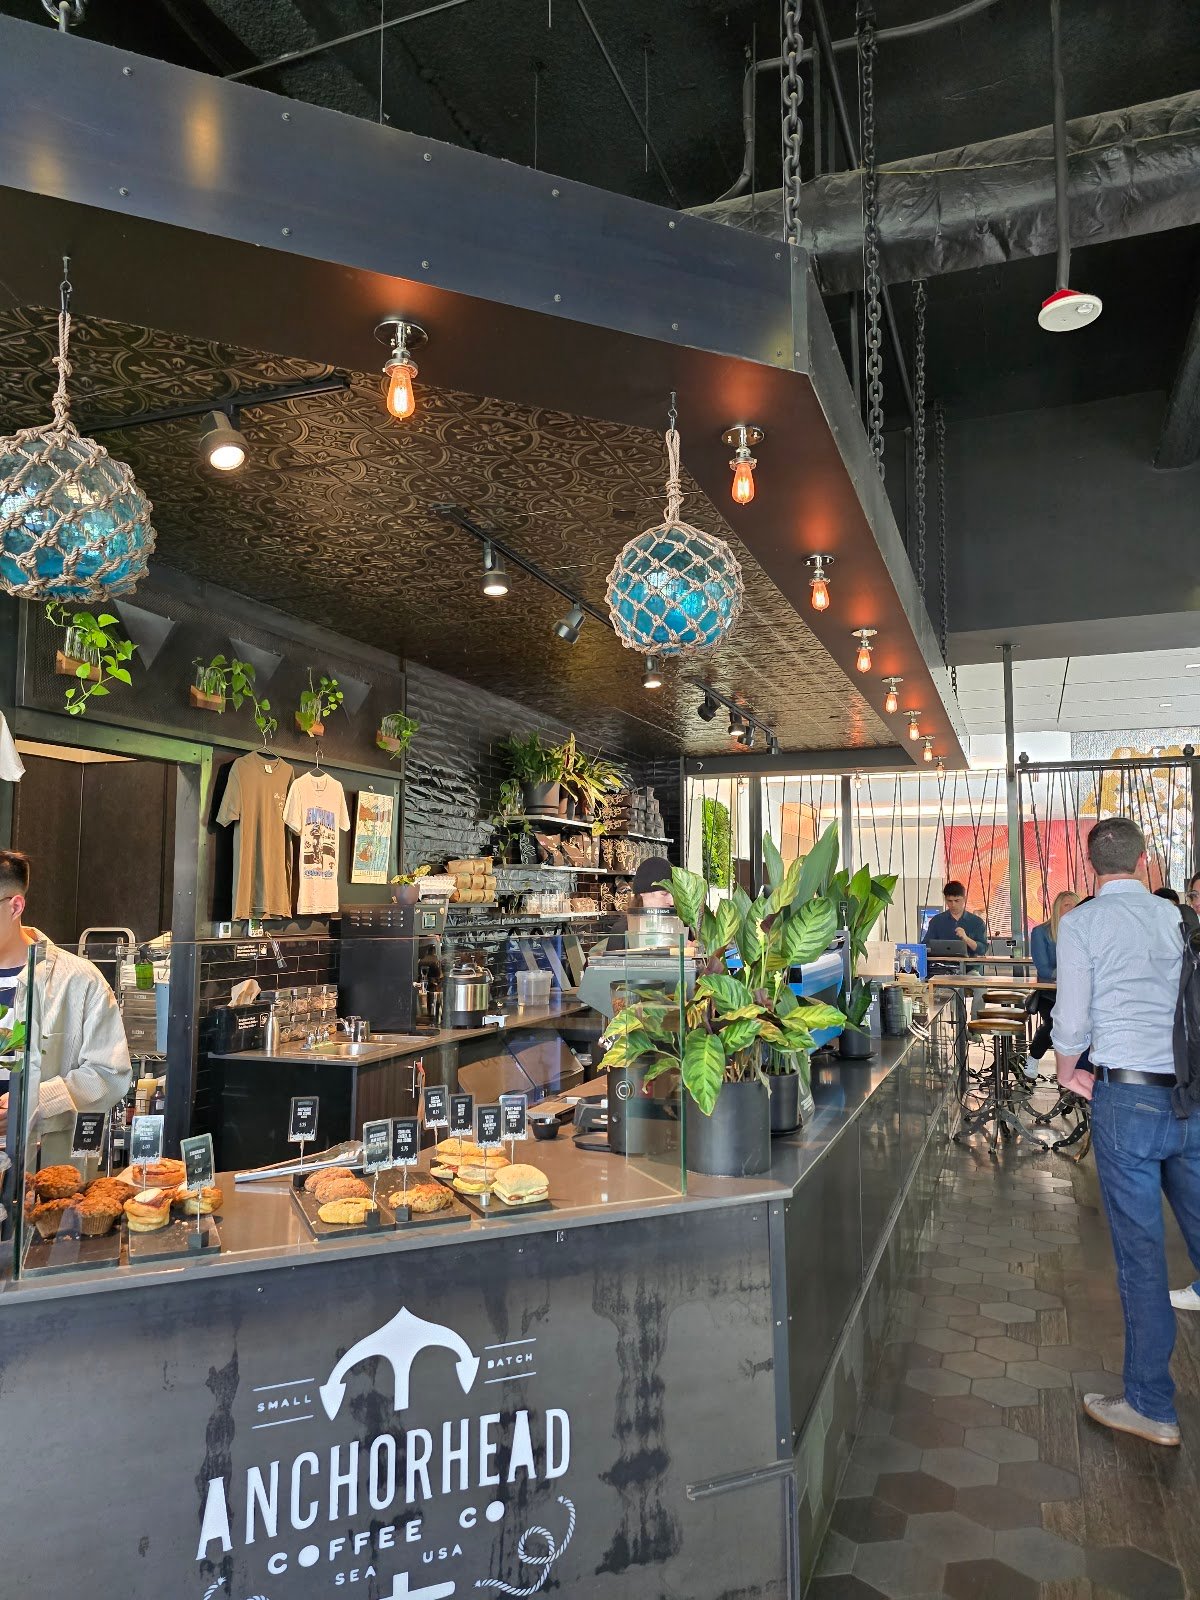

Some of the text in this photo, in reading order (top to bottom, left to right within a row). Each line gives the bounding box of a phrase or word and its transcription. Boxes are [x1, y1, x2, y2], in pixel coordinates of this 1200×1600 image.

[487, 1353, 534, 1369] BATCH
[256, 1394, 312, 1413] SMALL
[196, 1408, 571, 1561] ANCHORHEAD
[267, 1500, 505, 1575] COFFEE CO
[334, 1544, 463, 1586] SEA USA
